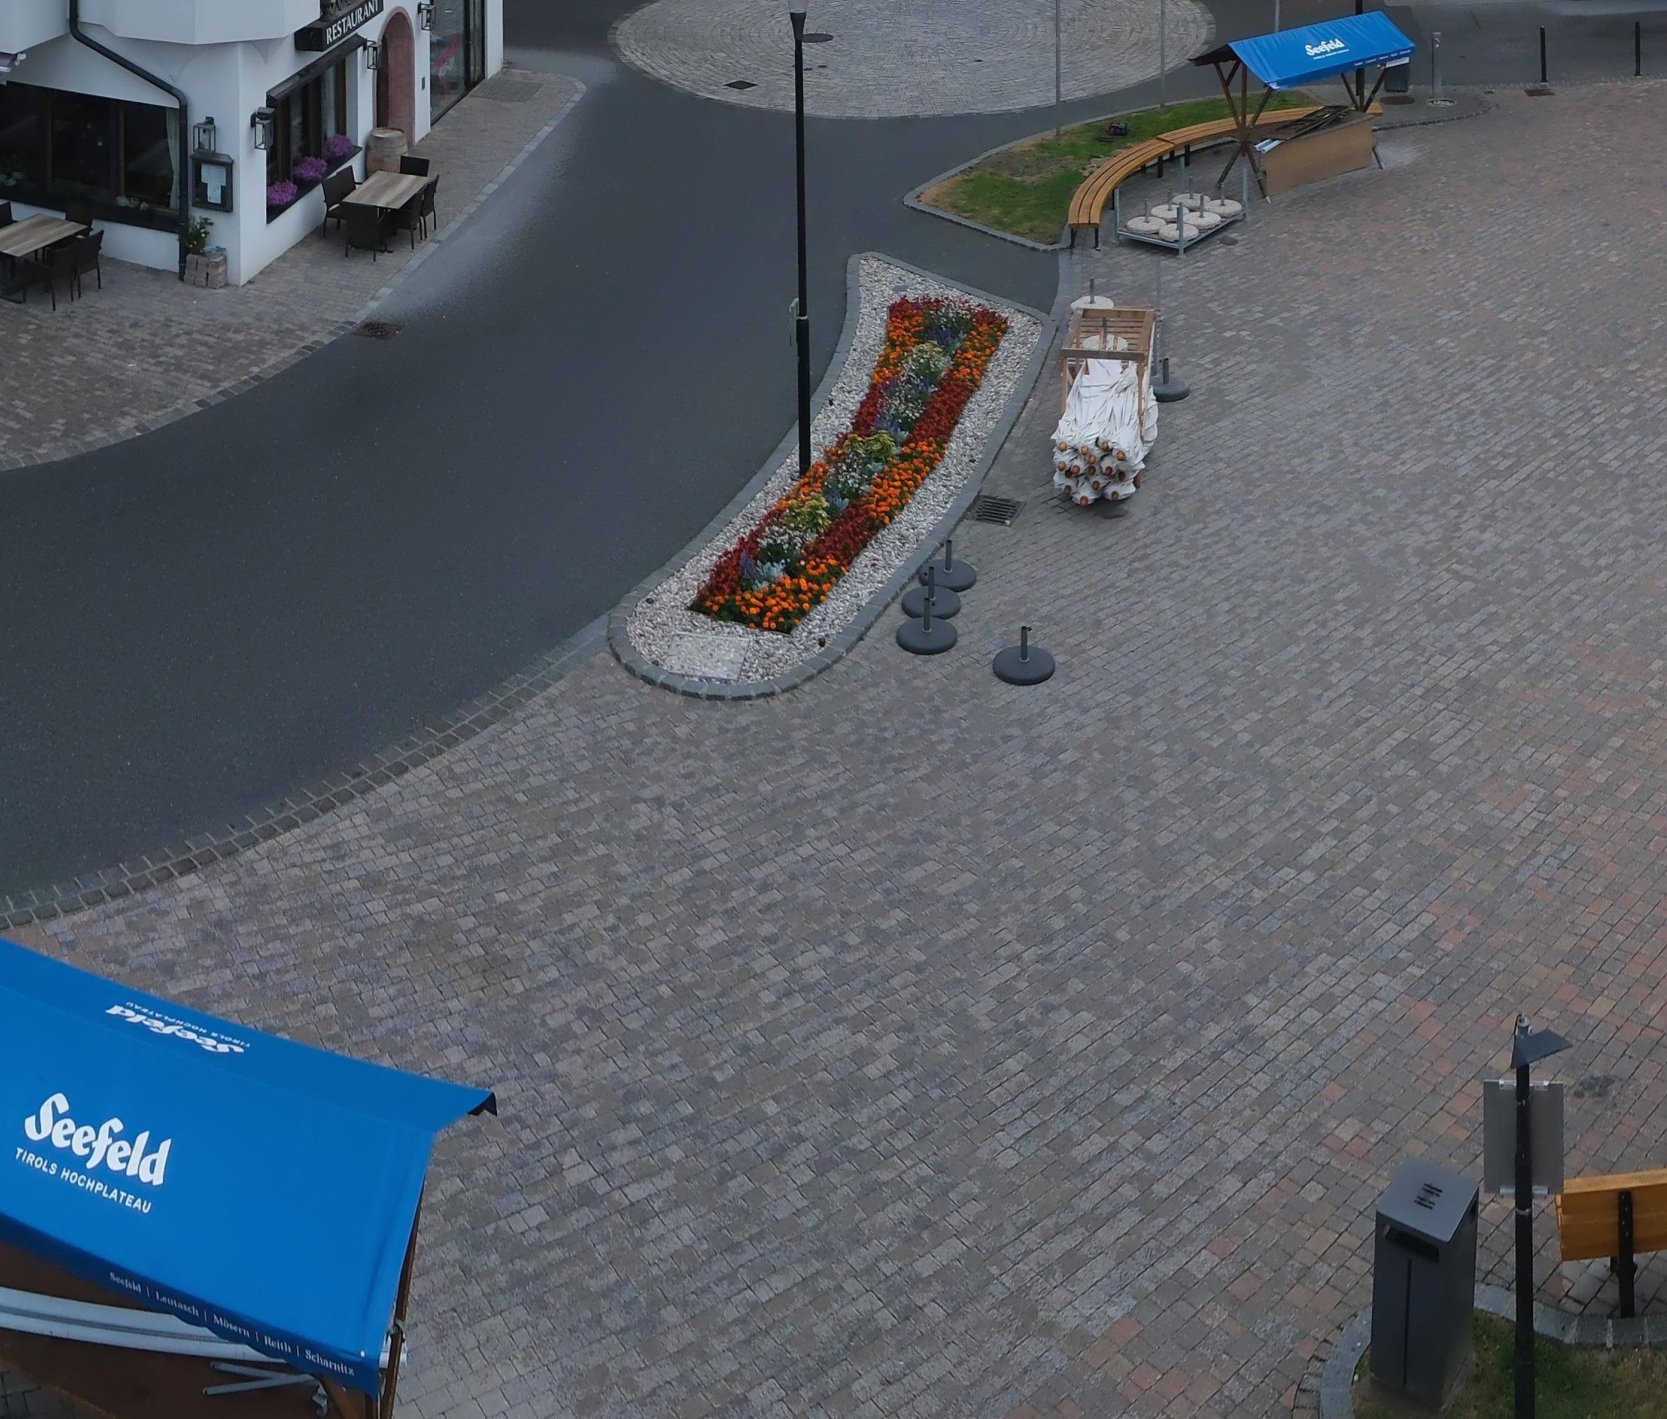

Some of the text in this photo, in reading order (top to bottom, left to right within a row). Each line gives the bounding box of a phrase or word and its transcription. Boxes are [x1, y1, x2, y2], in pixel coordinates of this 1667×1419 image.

[1305, 38, 1345, 56] Seefeld
[105, 1005, 245, 1053] Seefeld
[24, 1092, 172, 1186] Seefeld
[15, 1147, 152, 1214] TIROLS HOCHPLATEAU
[109, 1271, 355, 1376] Seefeld Leutasch Mösern Reith Scharnitz
